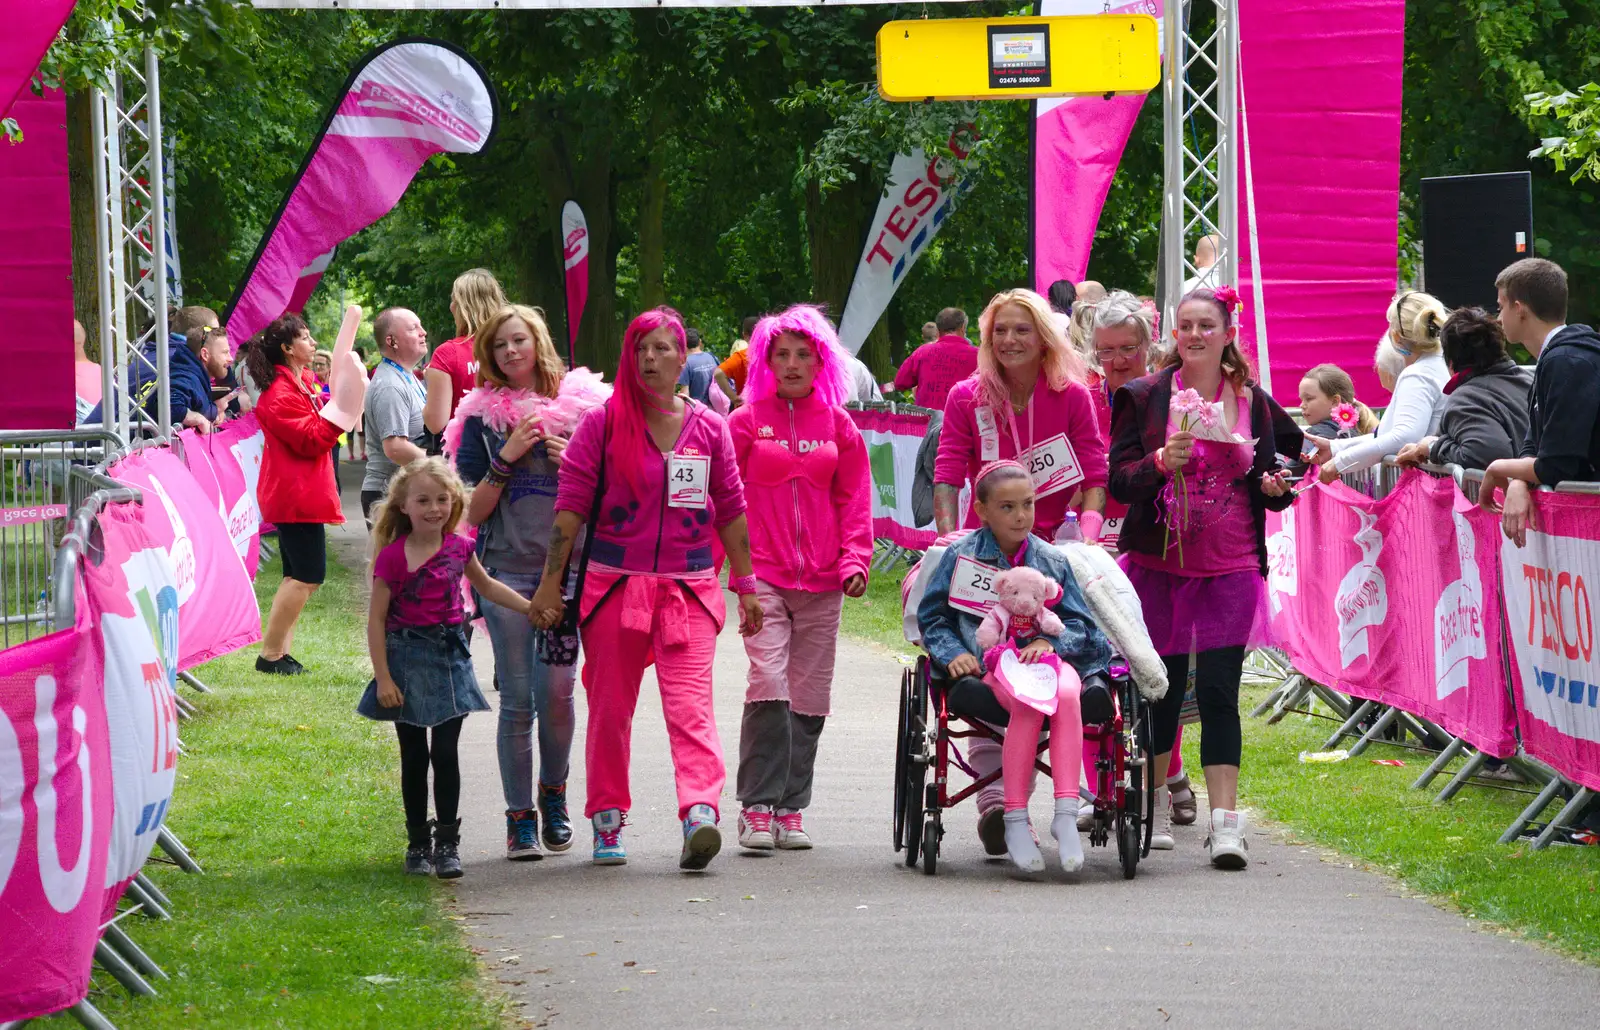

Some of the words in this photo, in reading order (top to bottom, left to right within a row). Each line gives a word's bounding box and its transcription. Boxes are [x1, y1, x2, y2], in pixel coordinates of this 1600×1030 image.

[370, 85, 409, 107] Race
[412, 99, 436, 119] for
[1026, 453, 1055, 475] 250
[971, 573, 998, 595] 25
[1522, 563, 1593, 663] TESCO
